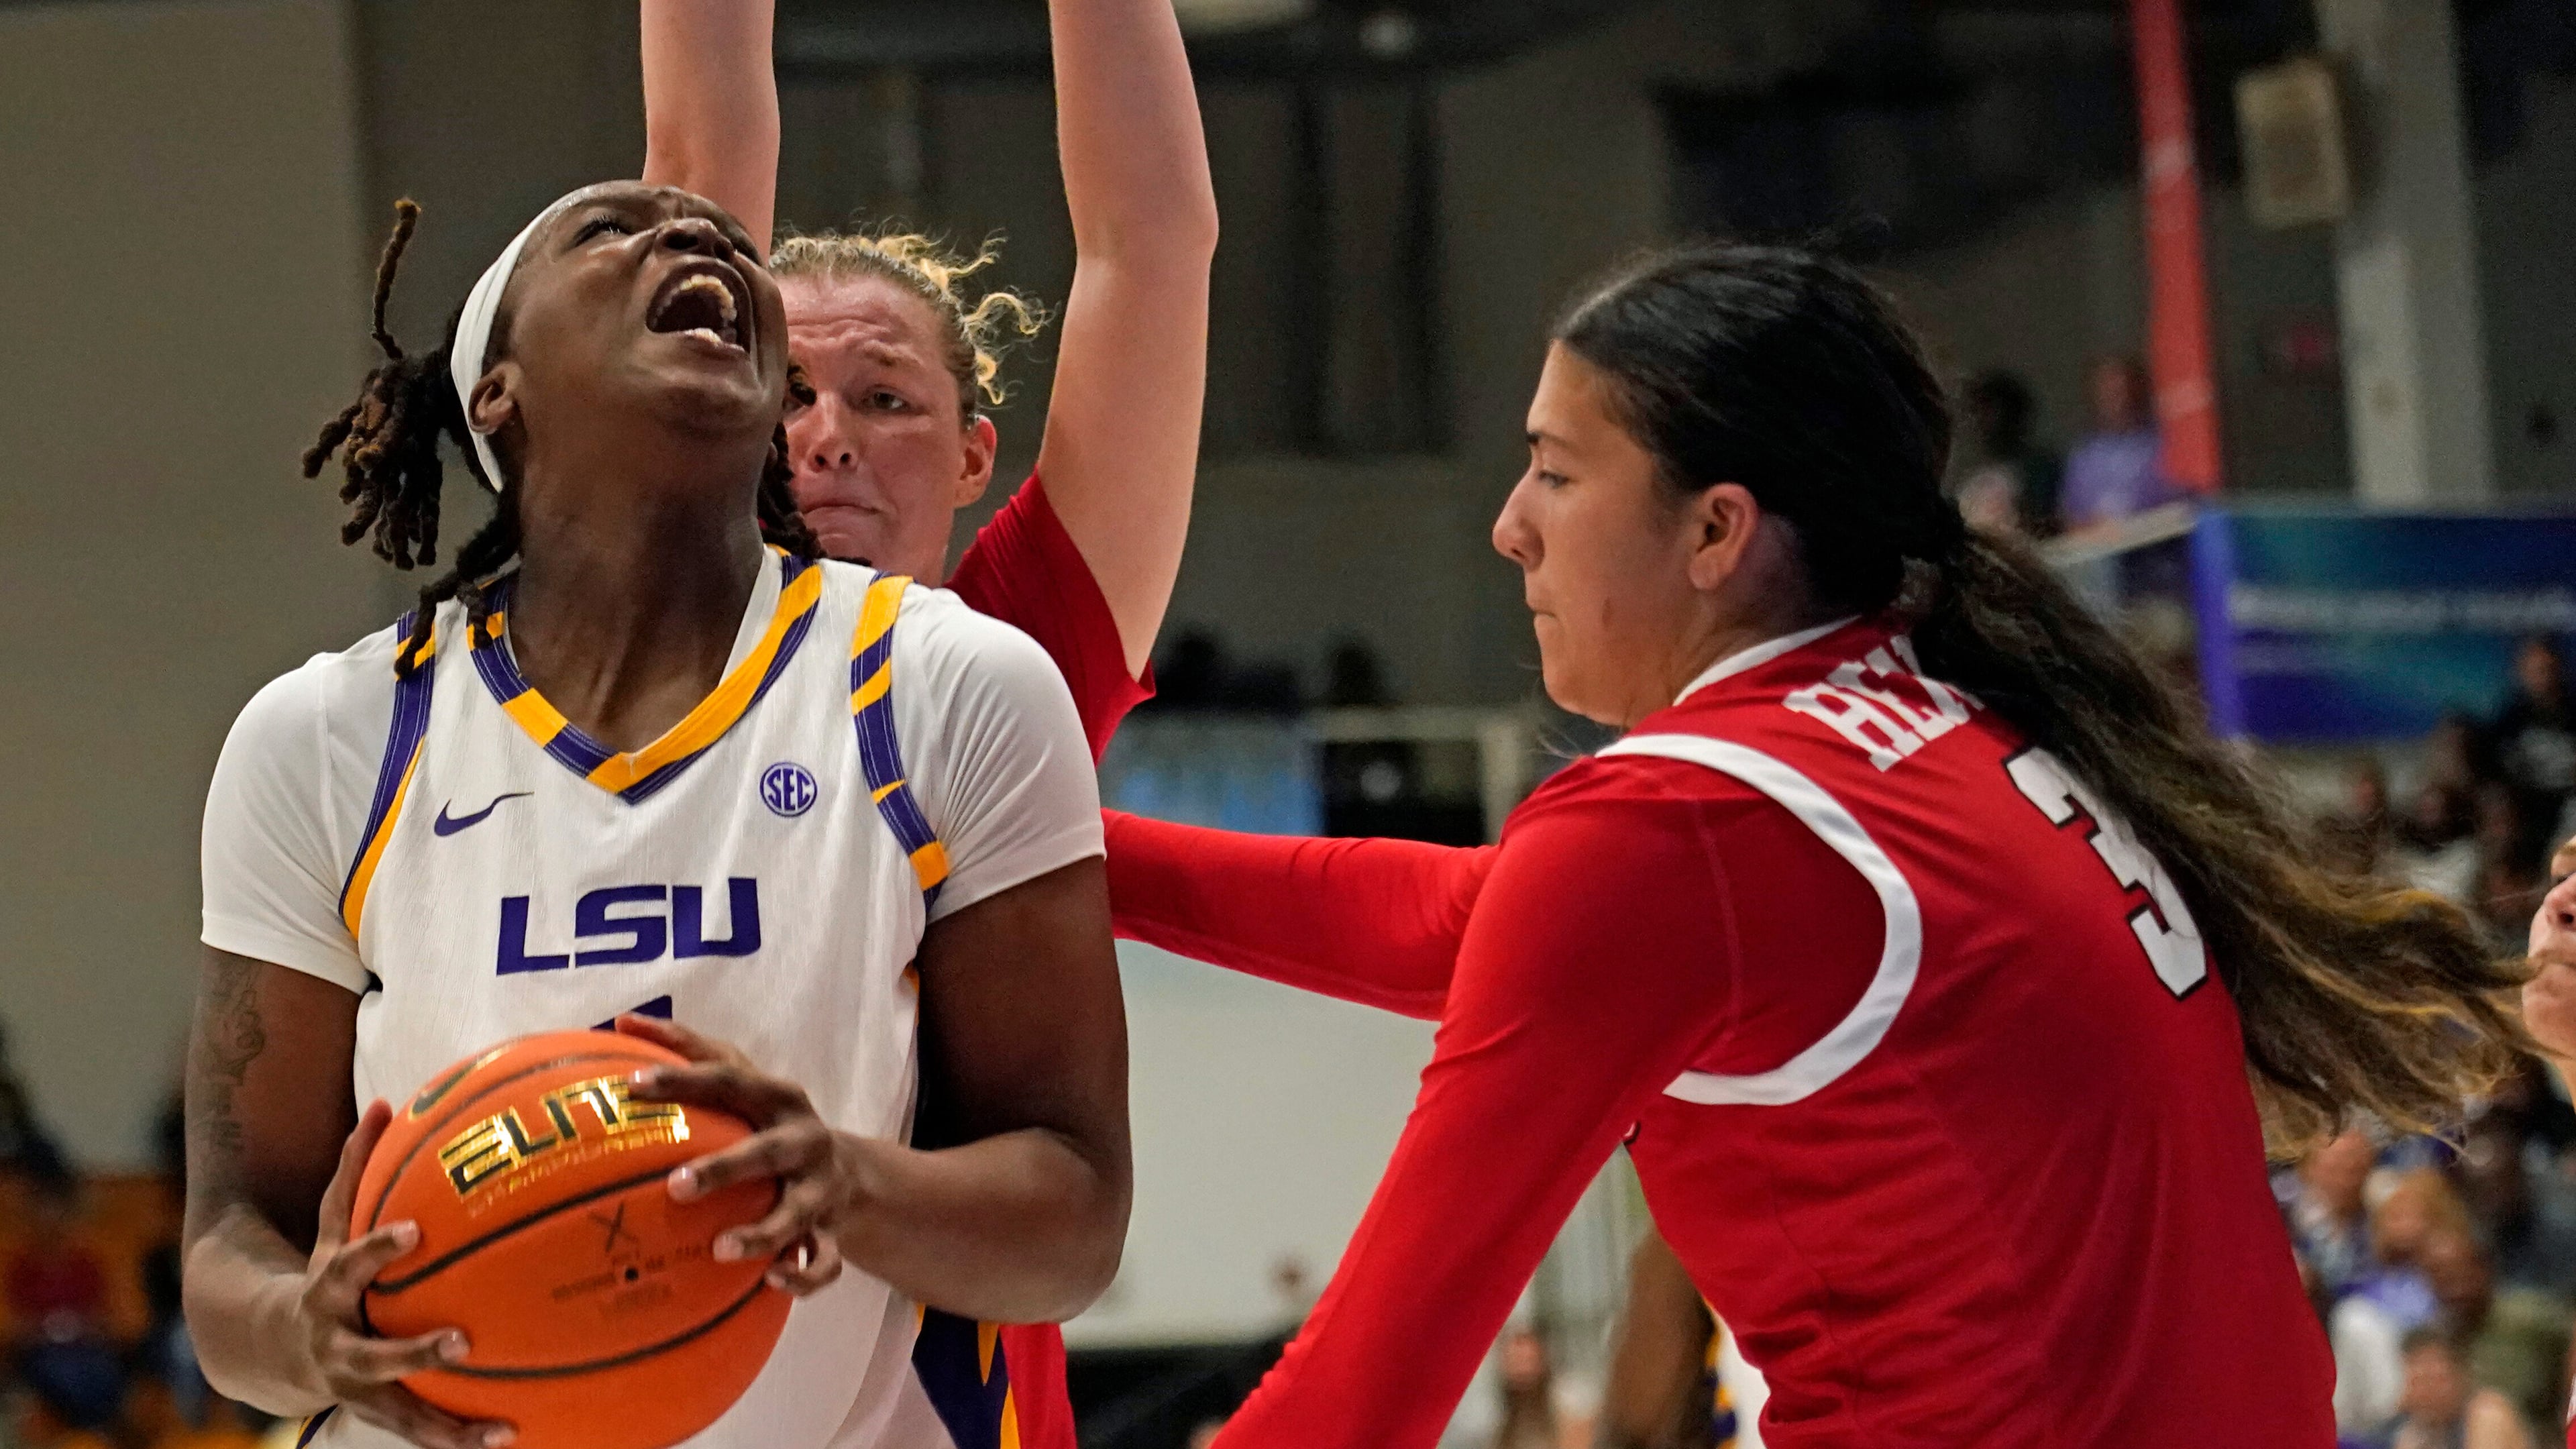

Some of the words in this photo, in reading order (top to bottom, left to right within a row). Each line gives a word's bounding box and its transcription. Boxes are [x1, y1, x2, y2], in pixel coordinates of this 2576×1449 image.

[766, 767, 812, 812] SEC
[496, 876, 762, 977] LSU
[2001, 746, 2208, 1001] 3
[438, 1075, 687, 1195] ELITE
